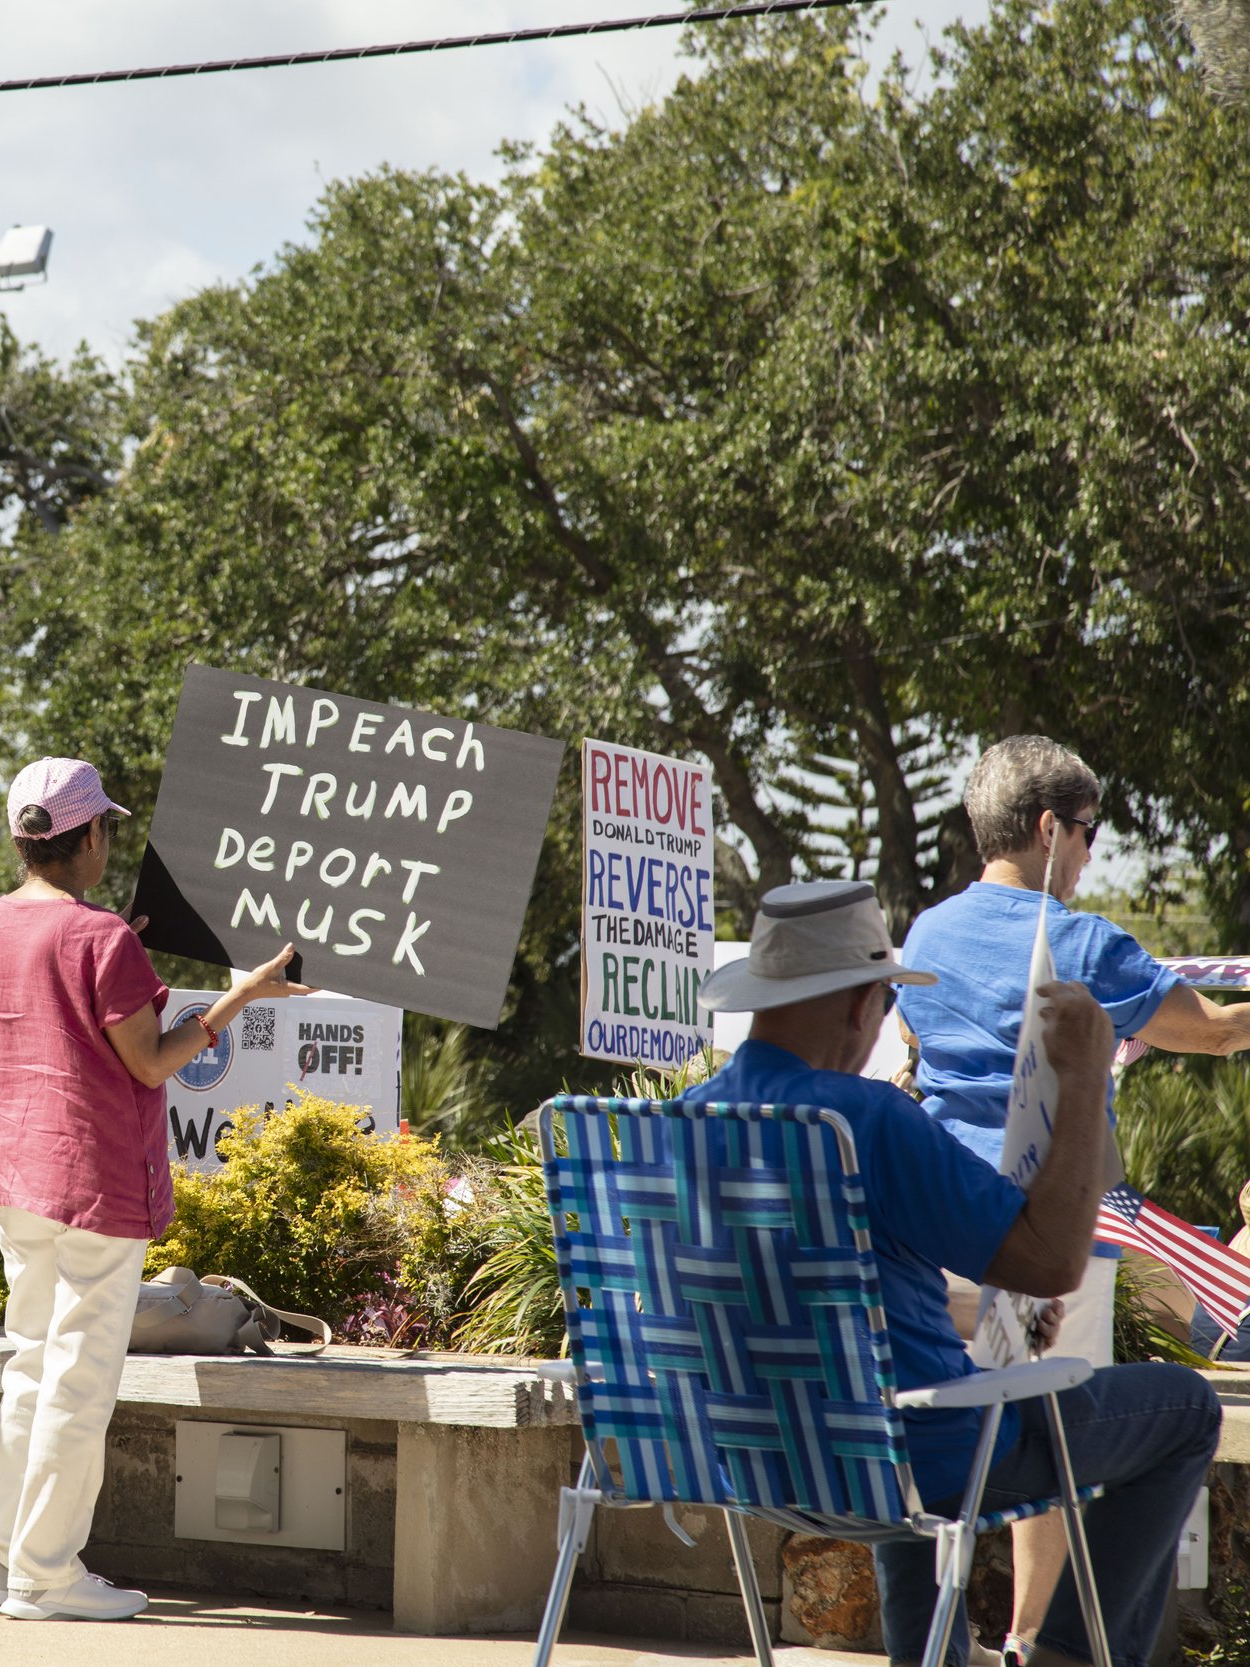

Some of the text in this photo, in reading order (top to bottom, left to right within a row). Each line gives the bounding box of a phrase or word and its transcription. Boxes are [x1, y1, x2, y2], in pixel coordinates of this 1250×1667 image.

[260, 763, 473, 834] TRUMP
[590, 749, 705, 837] REMOVE
[592, 819, 701, 857] DONALD TRUMP
[588, 848, 713, 931] REVERSE
[230, 888, 432, 977] MUSK
[591, 914, 699, 958] THE DAMAGE
[298, 1022, 364, 1042] HANDS
[588, 1018, 628, 1057] OUR
[298, 1044, 364, 1076] OFF!
